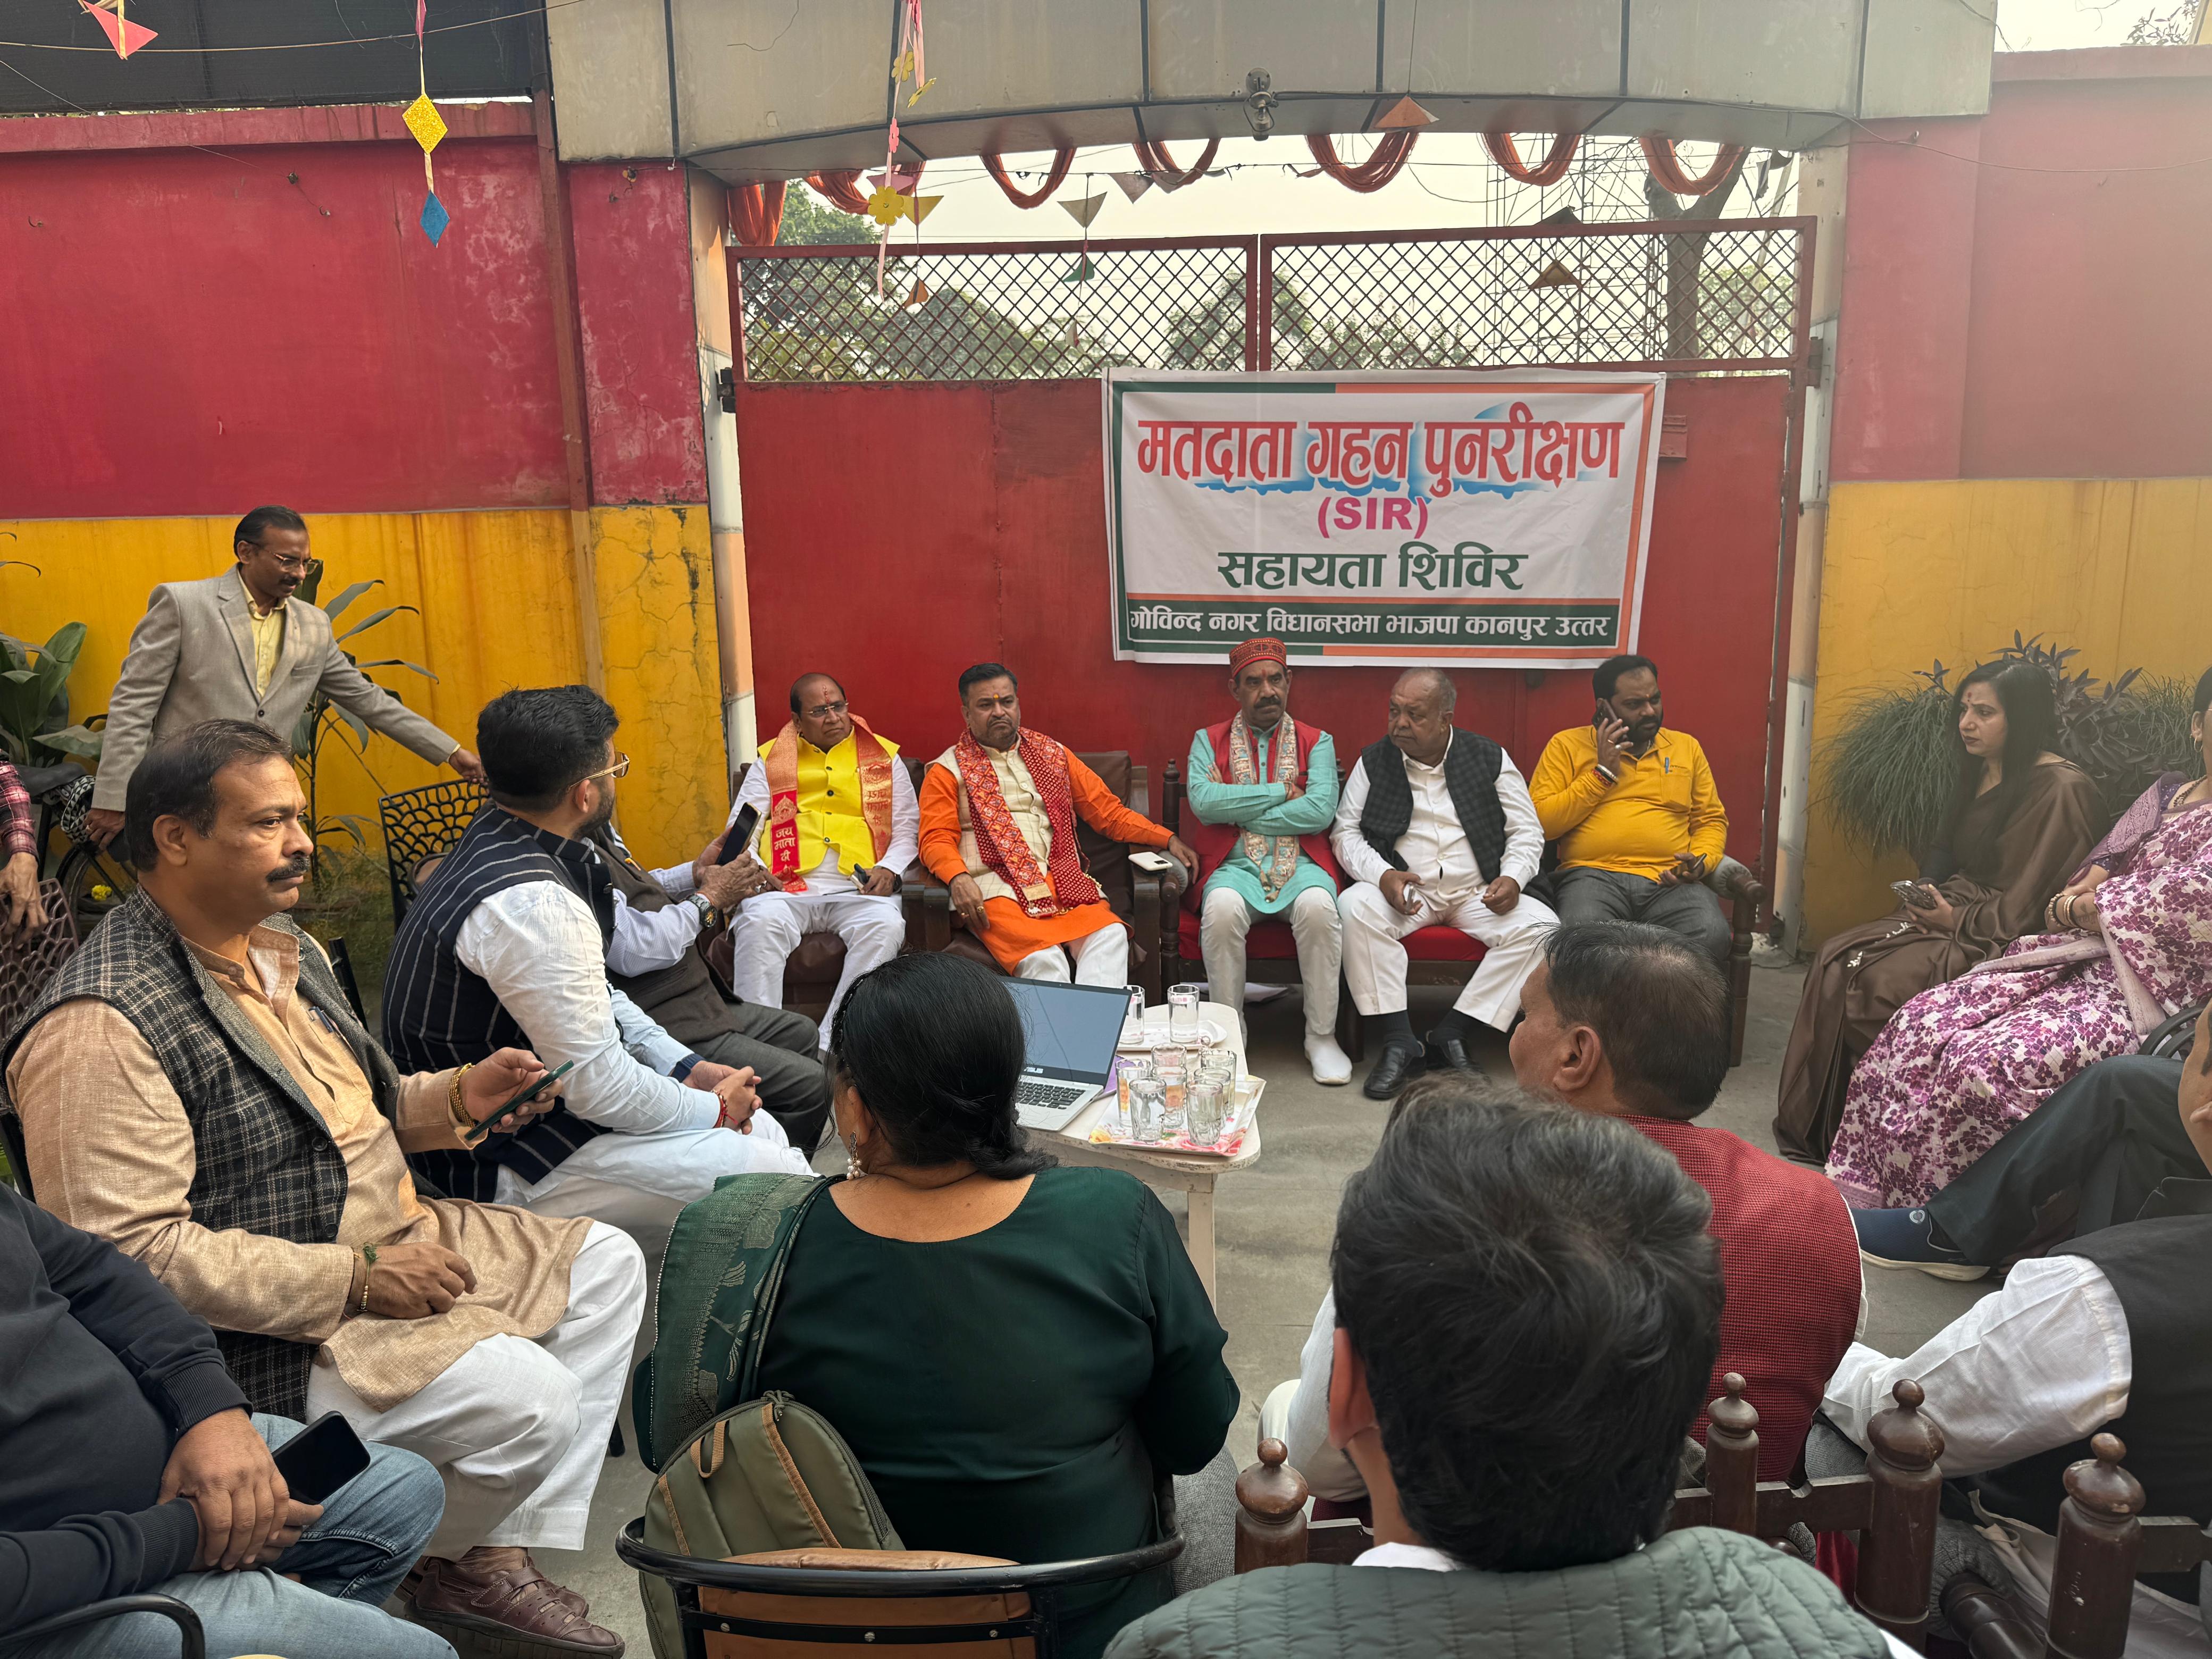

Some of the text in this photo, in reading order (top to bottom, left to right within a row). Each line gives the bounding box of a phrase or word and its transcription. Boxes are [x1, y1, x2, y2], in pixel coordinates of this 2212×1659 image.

[1138, 401, 1626, 498] मतदाता गहन पुनरीक्षण
[1318, 497, 1428, 539] (SIR)
[1218, 541, 1529, 591] सहायता शिविर
[1130, 605, 1611, 641] गोविन्द नगर विधानसभा भाजपा कानपुर उत्तर
[774, 837, 796, 851] माता
[776, 827, 794, 838] जय
[780, 849, 791, 861] दी
